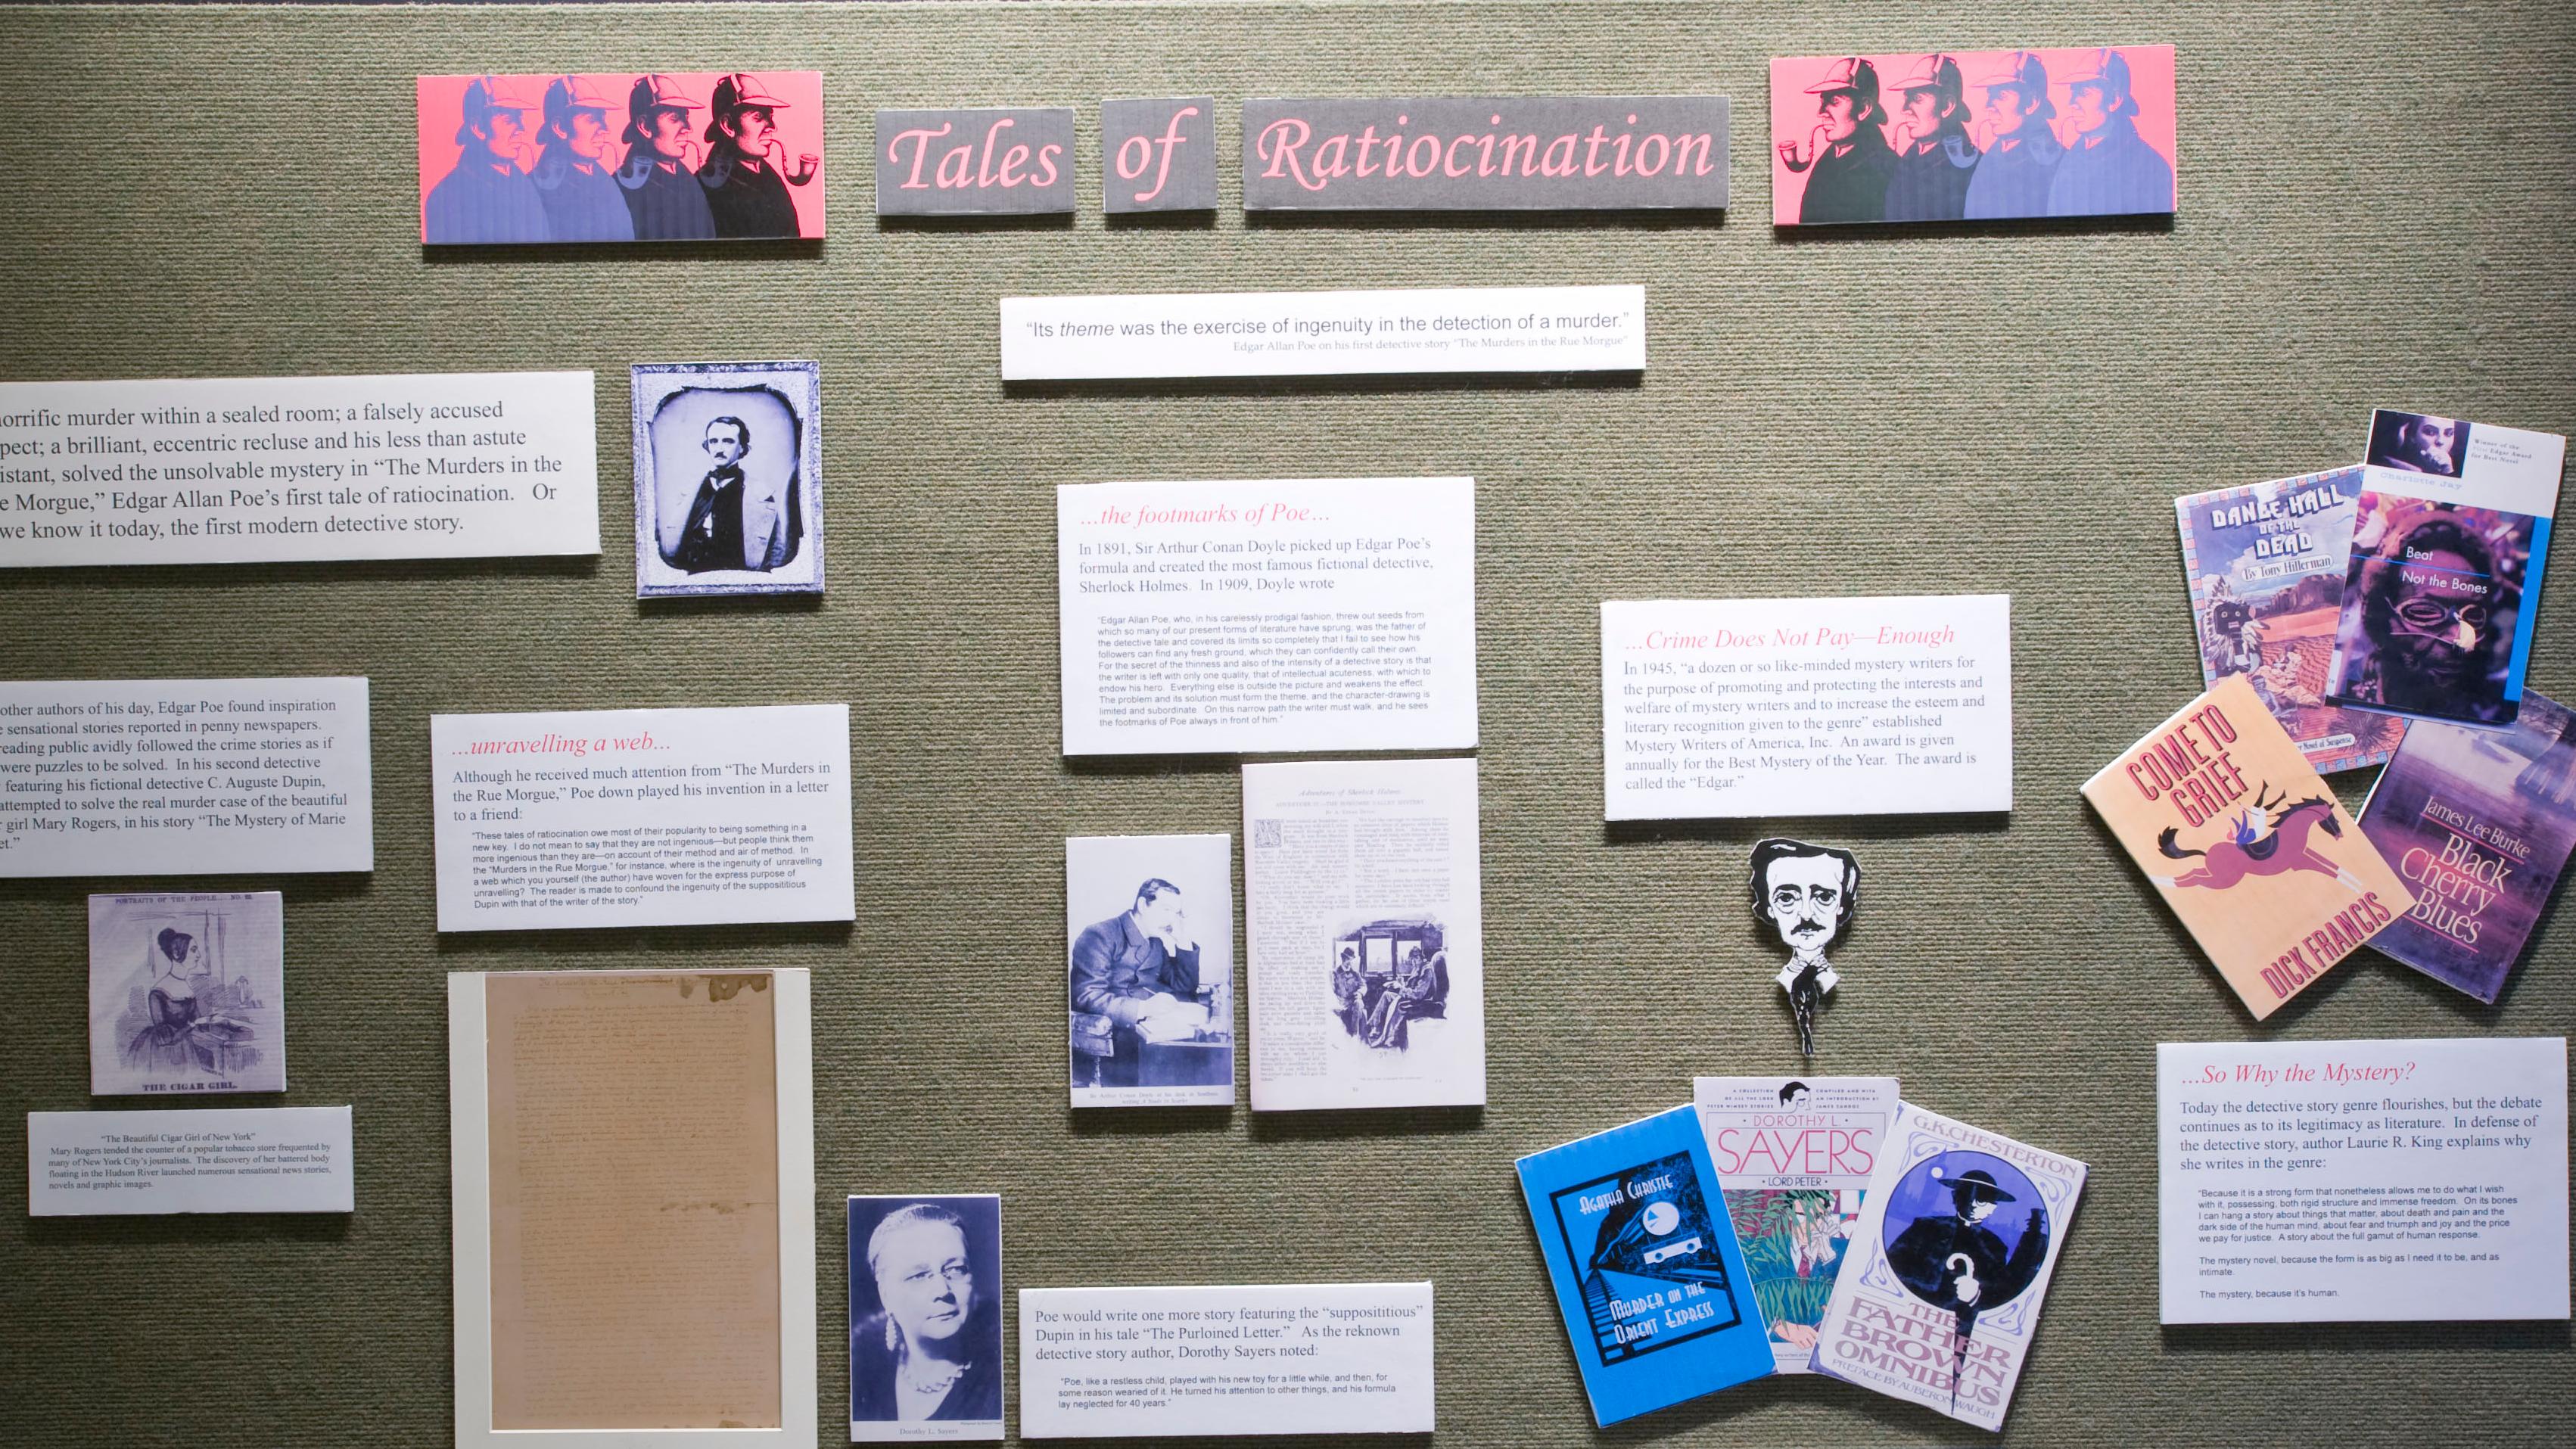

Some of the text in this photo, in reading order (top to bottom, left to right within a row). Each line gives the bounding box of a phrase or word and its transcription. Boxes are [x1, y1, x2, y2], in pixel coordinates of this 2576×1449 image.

[888, 107, 1715, 201] Tales of Ratiocination
[1027, 312, 1629, 337] “Its theme was the exercise of ingenuity in the detection of a murder.”
[0, 401, 502, 427] orrific murder within a sealed room; a falsely accused
[2380, 472, 2462, 490] Charlotte Jay
[1133, 504, 1238, 529] footmarks
[1246, 503, 1269, 527] of
[2211, 484, 2344, 528] DANCE HALL
[2254, 533, 2313, 559] DEAD
[2406, 546, 2434, 561] Beat
[2245, 557, 2332, 580] By Tony Hillerman
[1080, 578, 1334, 593] Sherlock Holmes. In 1909, Doyle wrote
[2402, 571, 2487, 594] Not the Bones
[1715, 630, 1765, 648] Does
[1773, 629, 1809, 646] Not
[0, 699, 336, 717] other authors of his day, Edgar Poe found inspiration
[594, 738, 605, 751] a
[2126, 704, 2237, 801] COME TO
[1626, 776, 1744, 791] called the “Edgar.”
[2170, 751, 2249, 827] GRIEF
[454, 807, 522, 821] to a friend:
[2422, 795, 2531, 859] James Lee Burke
[2438, 832, 2512, 894] Black
[2400, 847, 2497, 917] Cherry
[474, 900, 499, 910] Dupin
[501, 899, 518, 908] with
[540, 898, 548, 906] of
[592, 897, 599, 905] of
[602, 897, 614, 905] the
[618, 896, 643, 906] story.”
[2410, 887, 2482, 944] Blues
[2260, 947, 2317, 999] DICK
[2302, 891, 2391, 968] FRANCIS
[208, 1081, 238, 1090] GIRL.
[2237, 1064, 2278, 1087] Why
[2285, 1064, 2315, 1082] the
[2323, 1062, 2416, 1086] Mystery?
[1754, 1115, 1841, 1127] DOROTHY L.
[123, 1134, 158, 1143] Beautiful
[160, 1134, 183, 1144] Cigar
[232, 1133, 256, 1141] York”
[1718, 1129, 1874, 1174] SAYERS
[2181, 1157, 2326, 1171] she writes in the genre:
[1768, 1177, 1822, 1186] LORD PETER
[2219, 1291, 2253, 1300] mystery,
[2255, 1289, 2291, 1298] because
[1909, 1302, 1959, 1329] THE
[1848, 1295, 2013, 1370] FATHER
[1841, 1319, 2008, 1388] BROWN
[1835, 1339, 2000, 1407] OMNIBUS
[1833, 1359, 1883, 1381] PREFACE
[1884, 1376, 1899, 1387] BY
[1955, 1400, 1995, 1419] WAUGH
[1059, 1400, 1070, 1410] lay
[1073, 1399, 1113, 1410] neglected
[1115, 1399, 1128, 1407] for
[1143, 1398, 1171, 1410] years.”
[899, 1427, 926, 1436] Dorothy
[938, 1427, 958, 1435] Sayers
